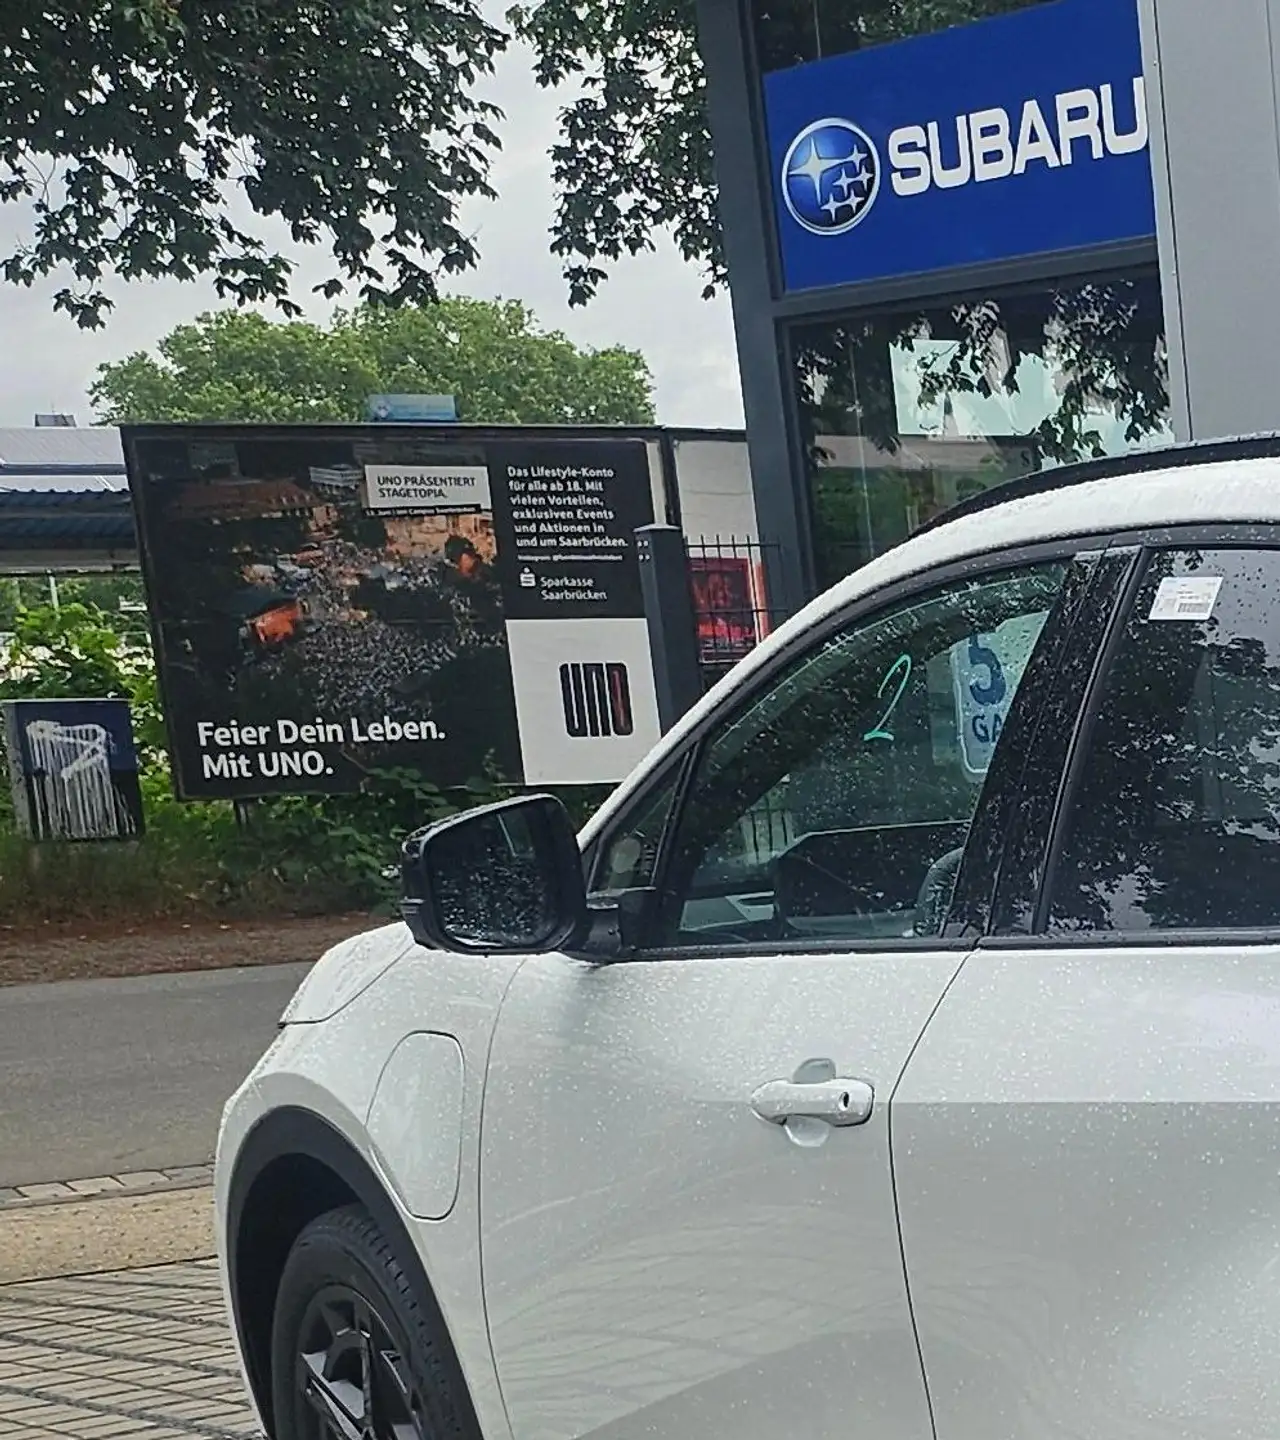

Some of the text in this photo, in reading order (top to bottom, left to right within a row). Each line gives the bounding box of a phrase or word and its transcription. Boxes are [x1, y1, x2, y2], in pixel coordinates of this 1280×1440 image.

[887, 76, 1149, 197] SUBARU
[506, 465, 615, 480] Das Lifestyle-Konto
[376, 473, 477, 488] UNO PRÄSENTIERT
[508, 479, 526, 491] für
[527, 480, 548, 492] alle
[549, 480, 564, 492] ab
[585, 479, 605, 492] Mit
[509, 494, 546, 506] vielen
[512, 508, 615, 520] exklusiven Events
[513, 521, 606, 533] und Aktionen in
[515, 535, 629, 548] und um Saarbrücken.
[540, 576, 595, 588] Sparkasse
[540, 589, 608, 600] Saarbrücken
[197, 716, 446, 747] Feier Dein Leben.
[203, 750, 334, 779] Mit UNO.
